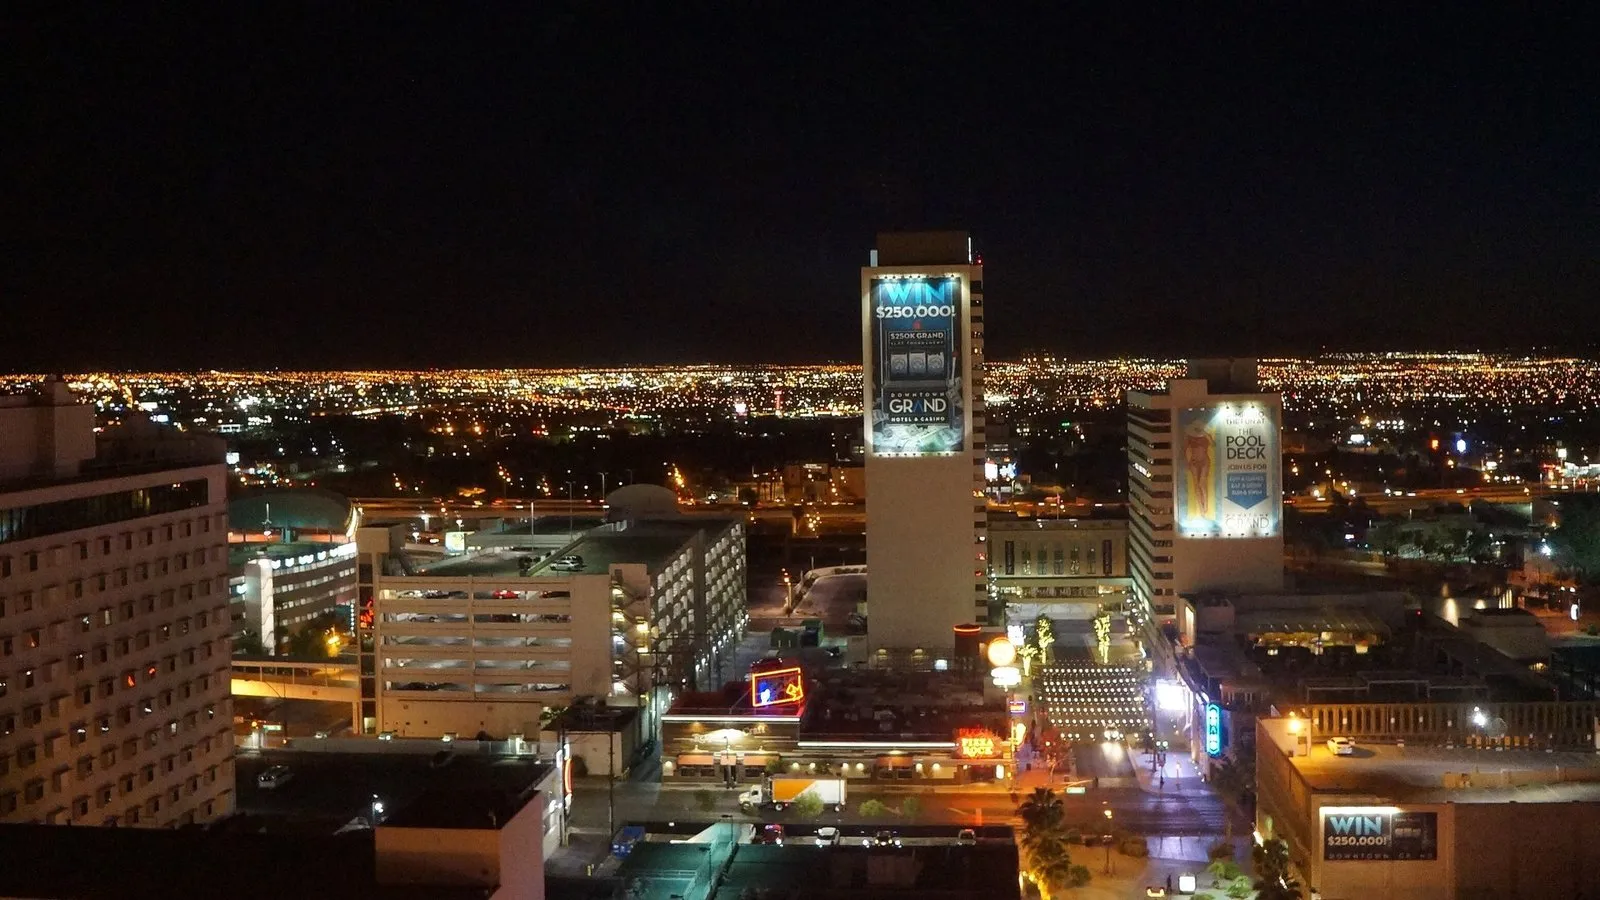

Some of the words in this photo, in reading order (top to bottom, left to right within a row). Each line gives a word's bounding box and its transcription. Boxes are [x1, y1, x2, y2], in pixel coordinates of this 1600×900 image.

[884, 282, 945, 304] WIN
[876, 305, 956, 319] $250,000!
[890, 332, 916, 340] $250K
[916, 331, 944, 340] GRAND
[889, 398, 947, 413] GRAND
[1238, 428, 1254, 436] THE
[1226, 435, 1266, 447] POOL
[1227, 447, 1266, 460] DECK
[961, 738, 994, 747] PIZZA
[962, 746, 993, 757] ROCK
[1329, 816, 1382, 836] WIN
[1327, 836, 1387, 847] $250,000!
